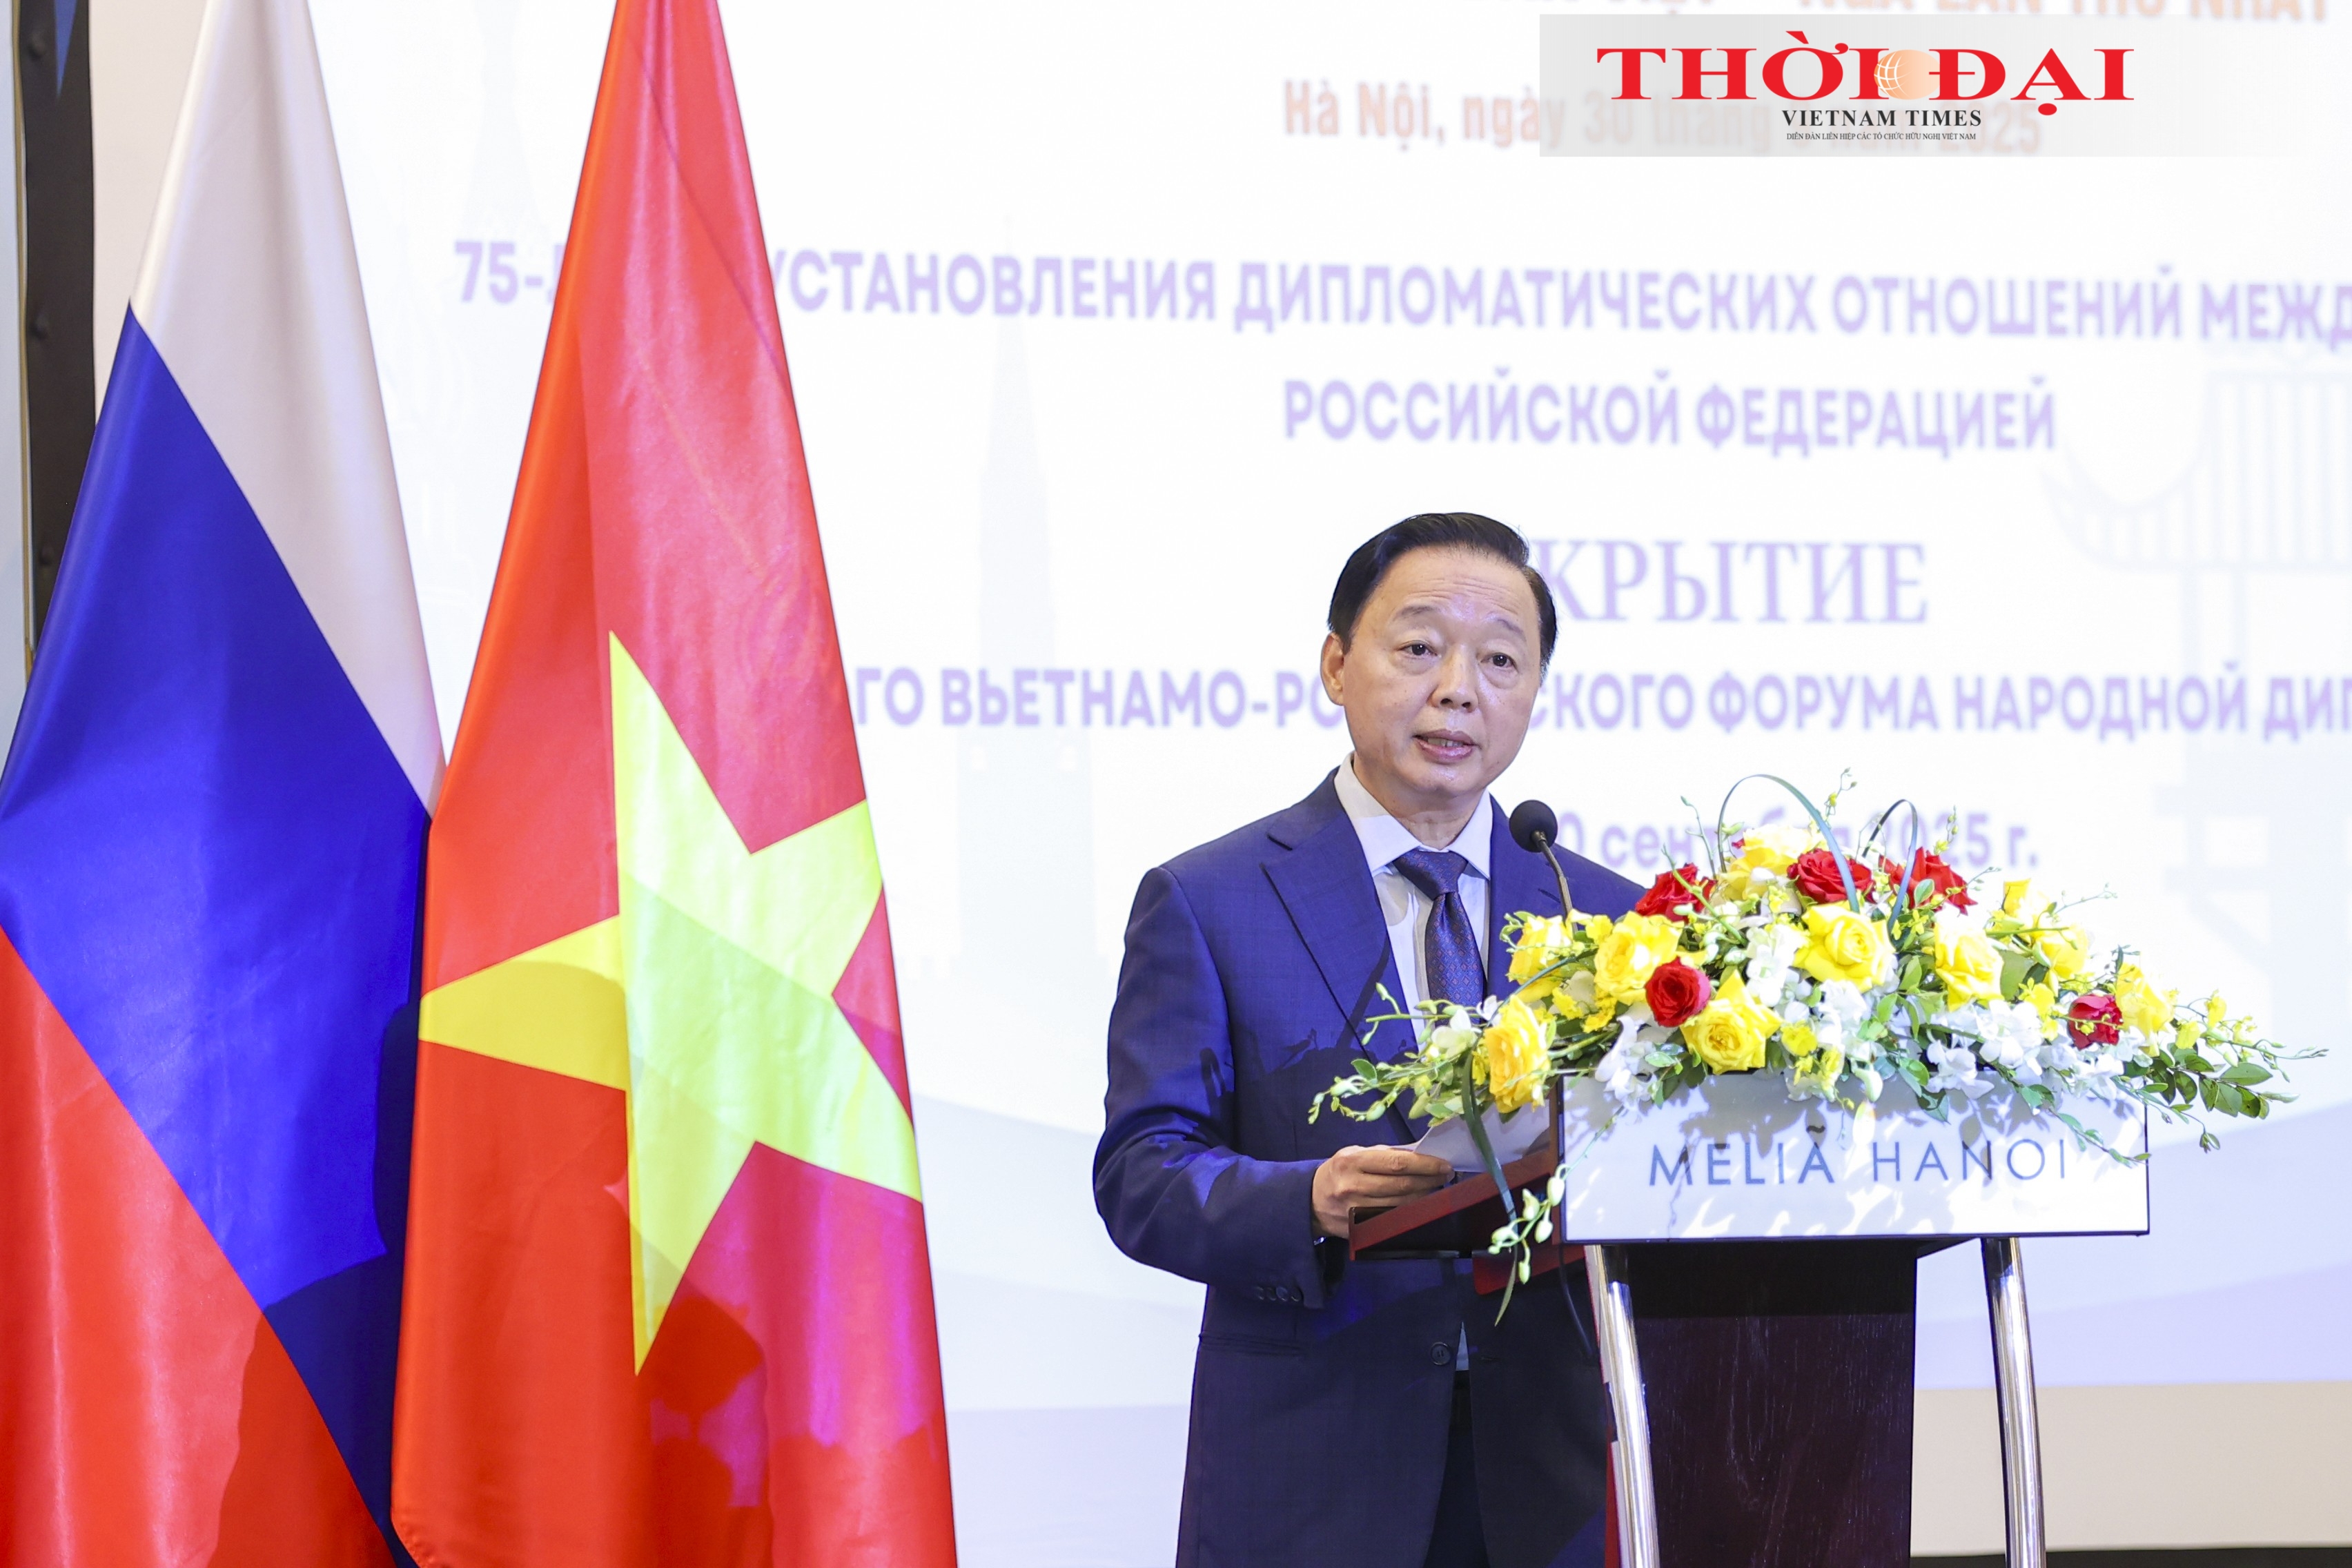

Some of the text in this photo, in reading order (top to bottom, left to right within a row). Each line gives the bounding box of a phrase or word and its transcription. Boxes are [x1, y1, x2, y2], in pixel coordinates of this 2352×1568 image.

[1284, 81, 1340, 136] Hà
[1358, 82, 1445, 151] Nội,
[1462, 85, 1566, 148] ngày
[1585, 90, 1633, 144] 30
[1938, 101, 2040, 153] 2025
[1233, 262, 1818, 335] ДИПЛОМАТИЧЕСКИХ
[1832, 264, 2183, 339] ОТНОШЕНИЙ
[1284, 367, 2056, 460] РОССИЙСКОЙ ФЕДЕРАЦИЕЙ
[1529, 538, 1928, 625] КРЫТИЕ
[854, 667, 925, 727] ГО
[1707, 671, 1941, 734] ФОРУМА
[1954, 660, 2248, 743] НАРОДНОЙ
[1558, 810, 1585, 856] 0
[2008, 825, 2039, 870] г.
[1872, 1138, 2065, 1182] HANOI
